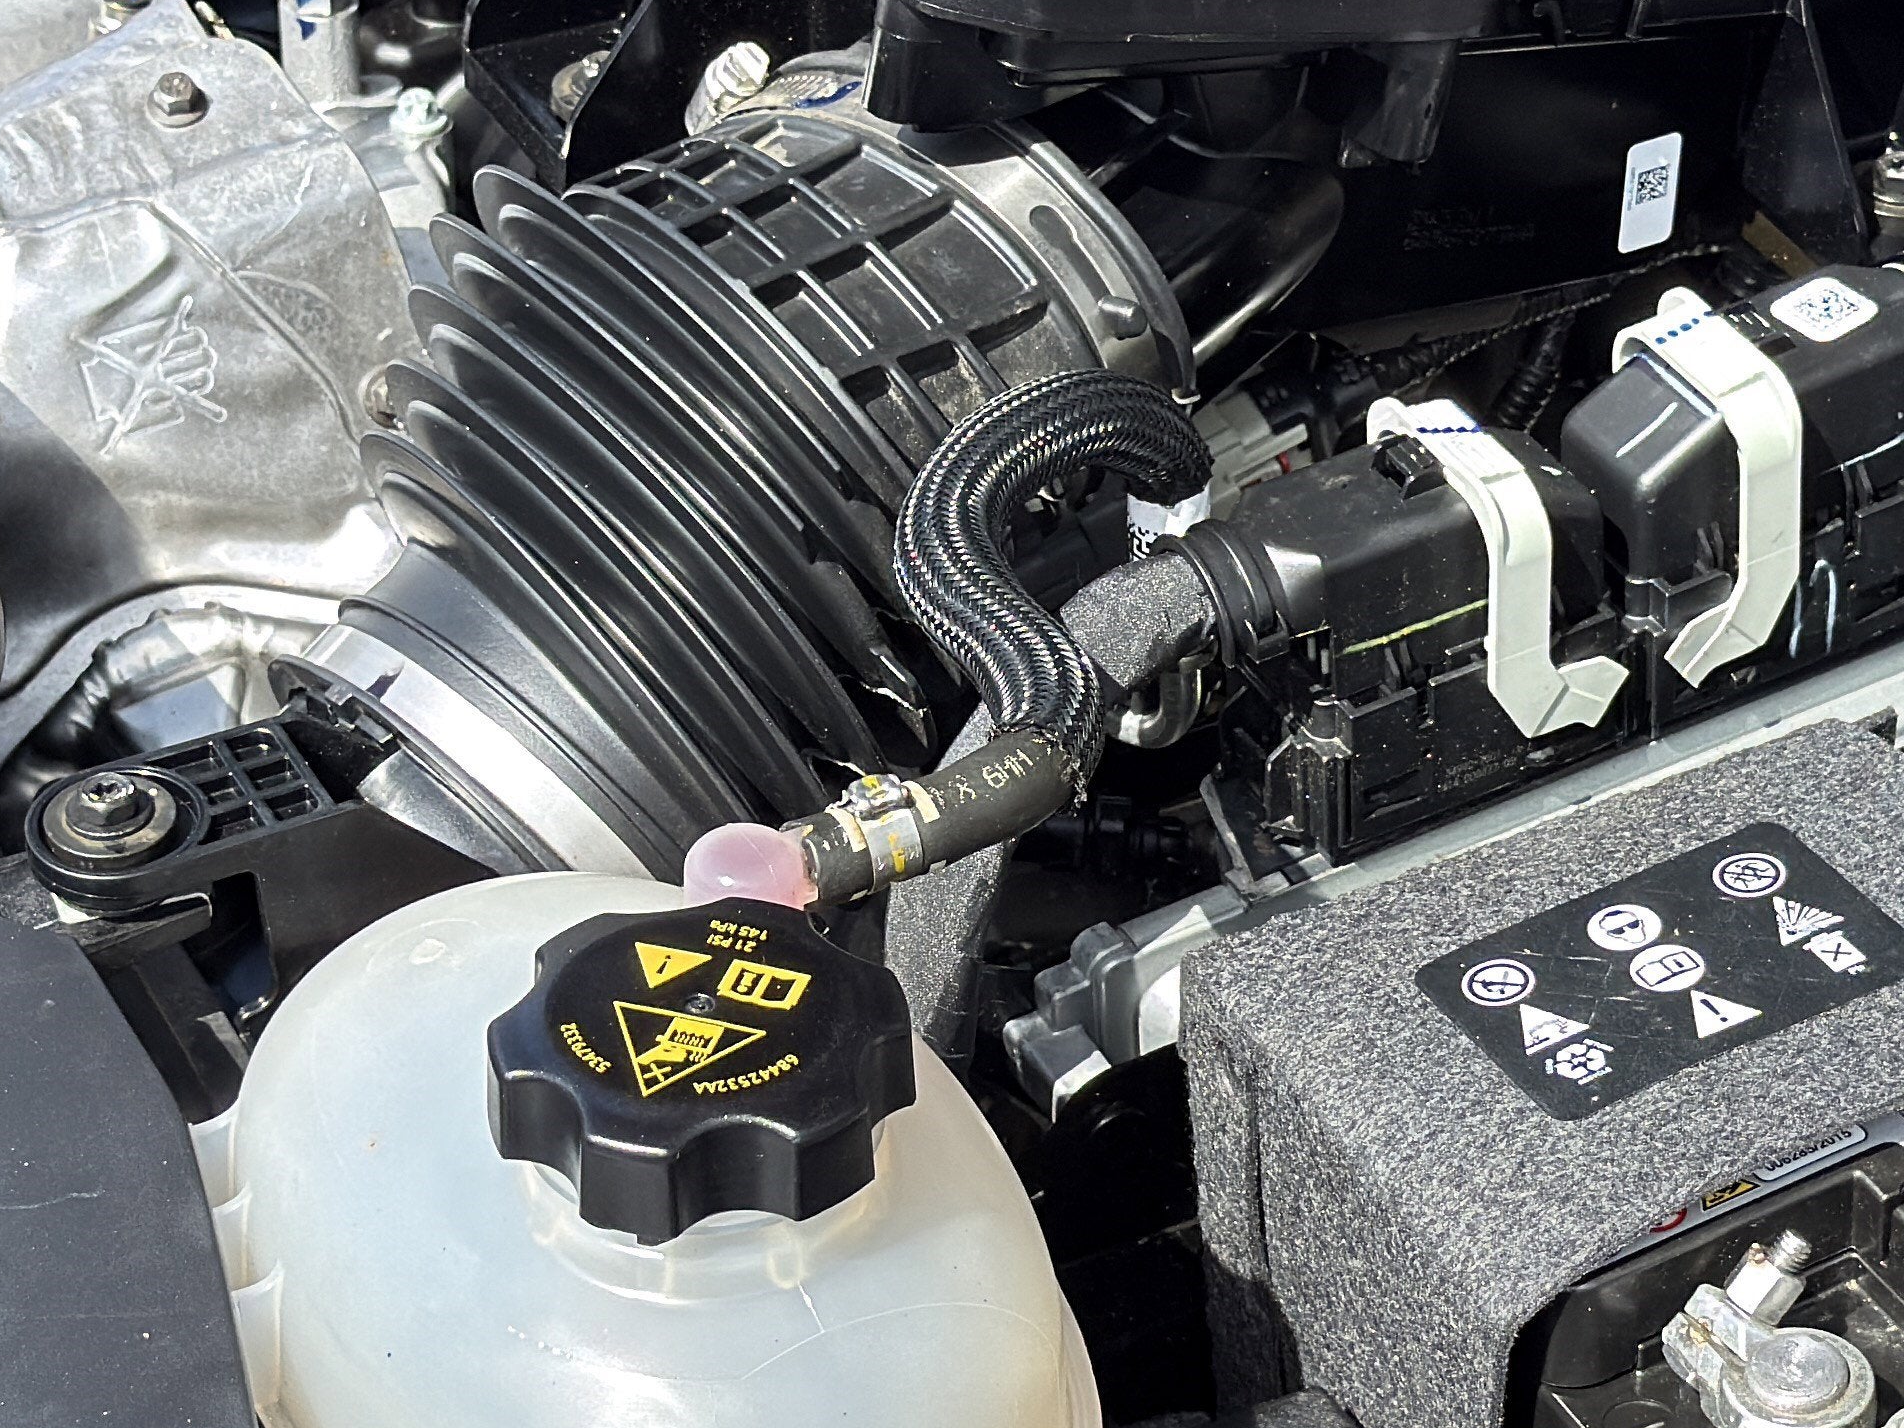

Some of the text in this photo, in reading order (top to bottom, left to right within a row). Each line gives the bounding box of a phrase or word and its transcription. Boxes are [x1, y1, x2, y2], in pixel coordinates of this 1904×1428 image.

[706, 933, 757, 952] 21 PSI
[737, 925, 768, 942] 145
[692, 1053, 800, 1095] 68442532AA
